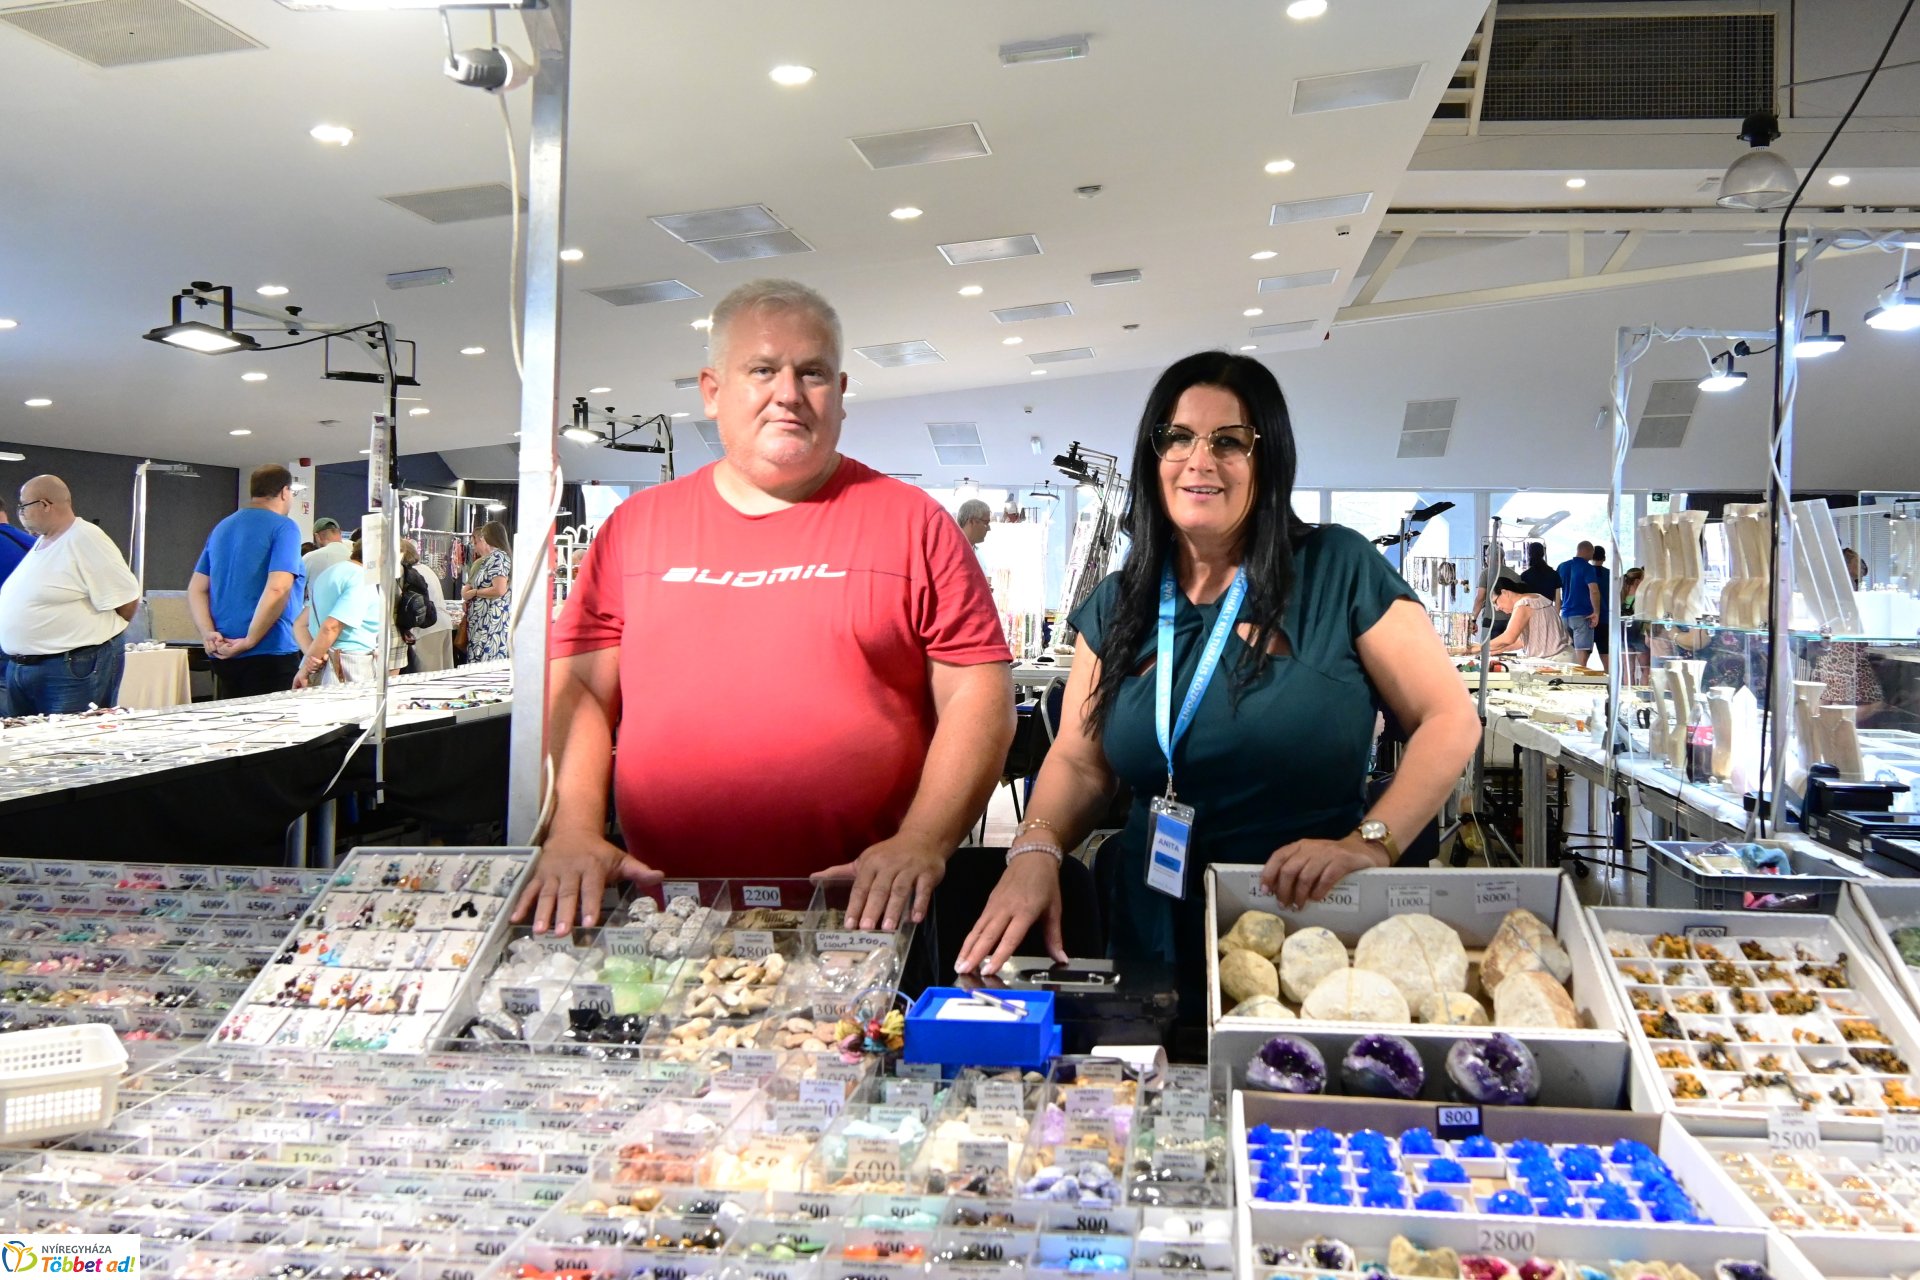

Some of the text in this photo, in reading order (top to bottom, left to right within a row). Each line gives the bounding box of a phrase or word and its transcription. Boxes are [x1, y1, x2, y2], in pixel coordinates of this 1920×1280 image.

[1158, 838, 1179, 852] ANITA
[744, 889, 779, 902] 2200
[1390, 896, 1424, 907] 11000
[1475, 892, 1511, 904] 18000
[611, 943, 644, 956] 1000
[738, 945, 774, 957] 2800
[578, 999, 611, 1015] 600
[1444, 1110, 1472, 1124] 800
[1770, 1131, 1817, 1150] 2500
[854, 1160, 896, 1182] 600
[1077, 1216, 1108, 1231] 800
[1480, 1230, 1535, 1251] 2800
